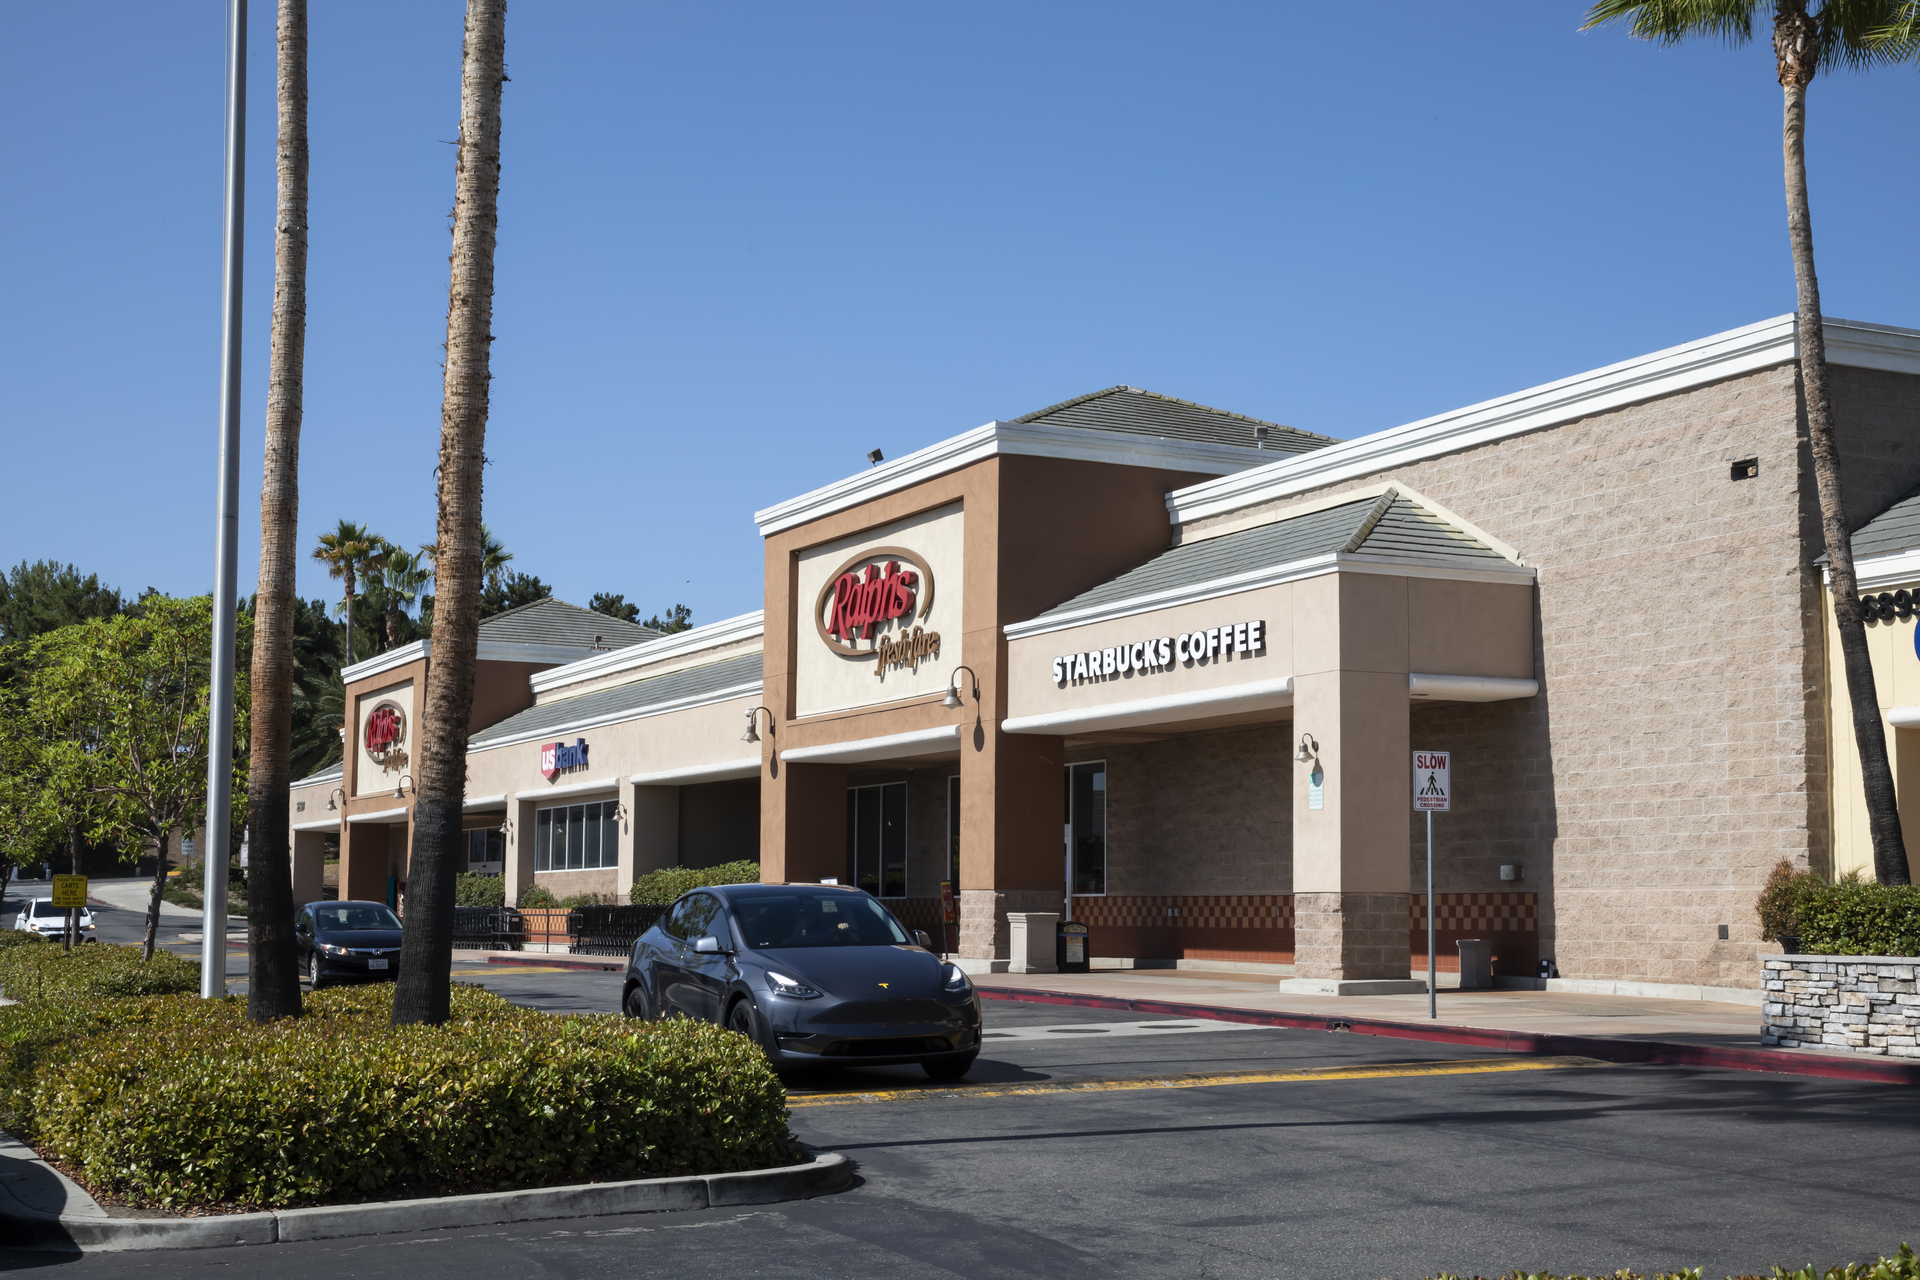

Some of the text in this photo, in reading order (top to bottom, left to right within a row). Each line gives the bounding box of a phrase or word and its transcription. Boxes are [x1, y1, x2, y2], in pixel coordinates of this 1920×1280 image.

[826, 560, 918, 641] Ralphs
[874, 625, 939, 677] fresh fare
[1051, 619, 1265, 684] STARBUCKS COFFEE
[1417, 754, 1446, 769] SLOW
